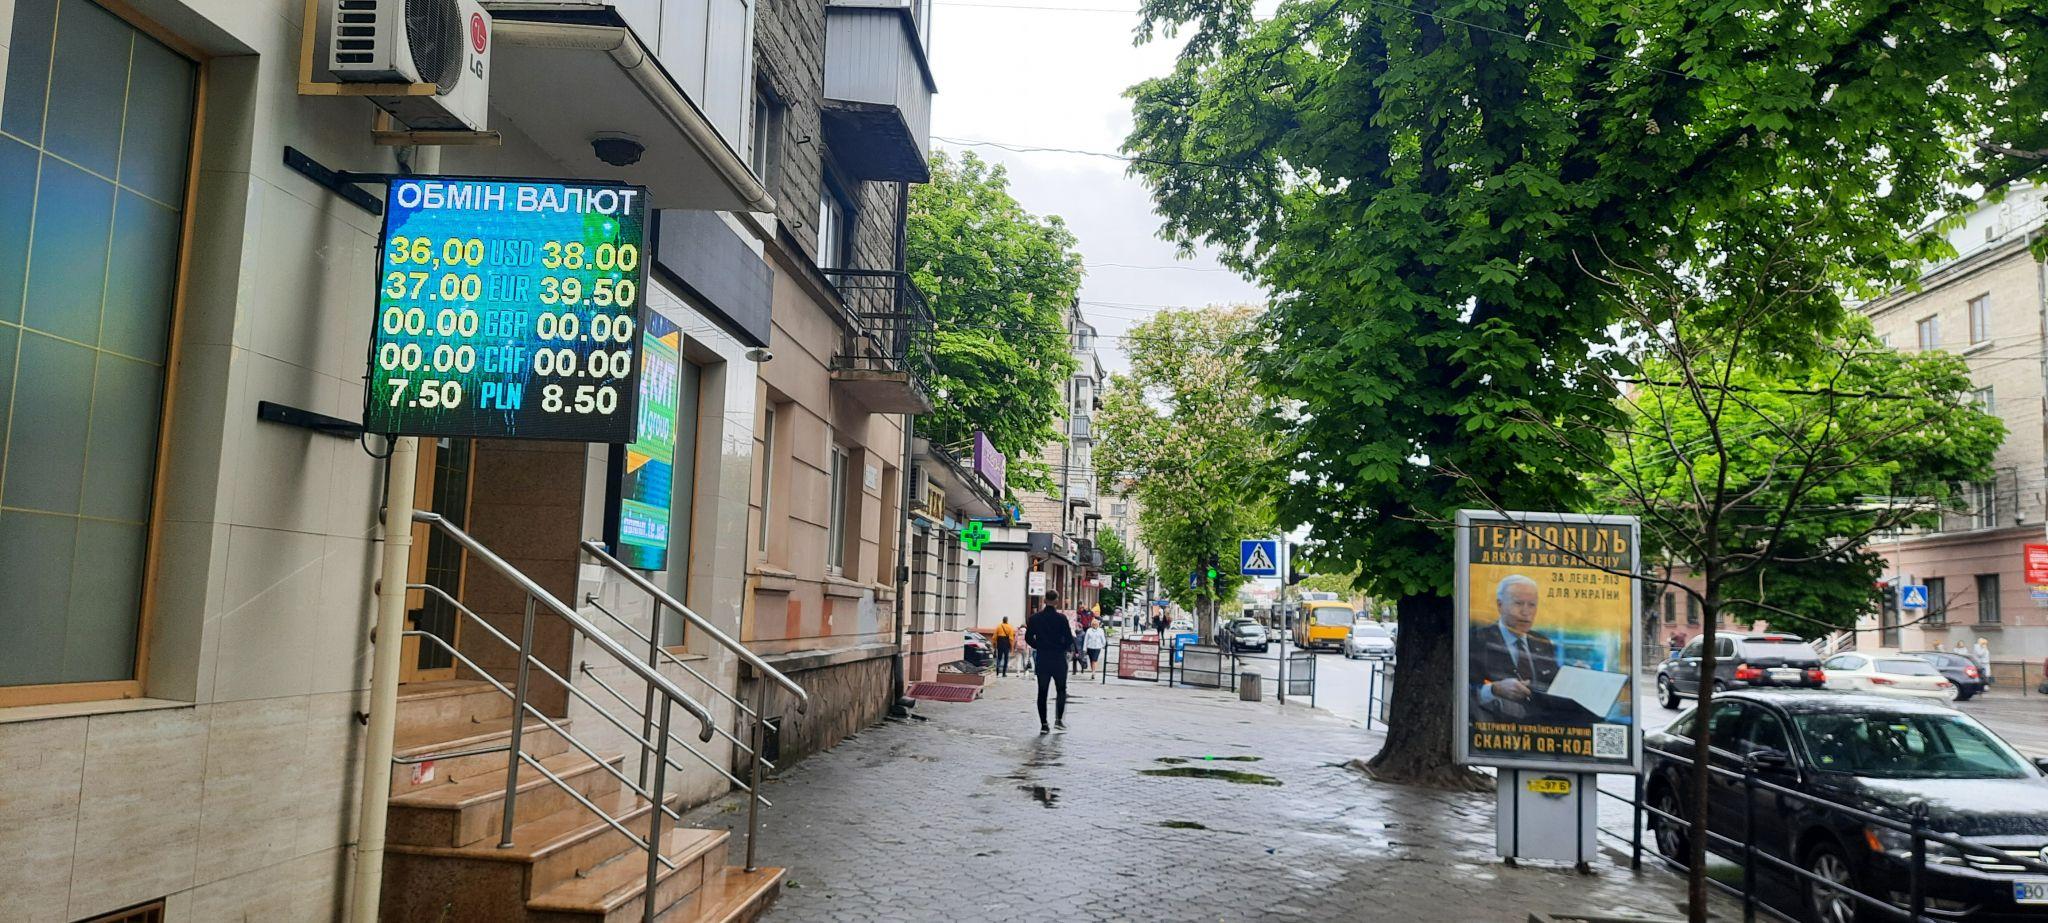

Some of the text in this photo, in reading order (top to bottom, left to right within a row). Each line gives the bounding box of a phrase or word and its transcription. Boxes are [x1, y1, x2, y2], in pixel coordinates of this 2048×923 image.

[470, 53, 483, 80] LG
[398, 183, 638, 215] ОБМІН ВАЛЮТ
[490, 240, 534, 267] USD
[542, 241, 638, 271] 38.00
[386, 271, 636, 307] 37.00 EUR 39.50
[383, 306, 633, 342] 00.00 GBP 00.00
[379, 342, 631, 379] 00.00 CHF 00.00
[388, 378, 618, 415] 7.50 PLN 8.50
[1476, 524, 1627, 554] ТЕРНОПІЛЬ
[1482, 551, 1523, 563] ДЯКУЄ
[1529, 553, 1556, 565] ДЖО
[1547, 587, 1620, 600] ДЛЯ УКРАЇНИ
[1552, 572, 1620, 585] ЗА ЛЕНД-ЛІЗ
[1474, 734, 1593, 755] СКАНУЙ QR-КОД
